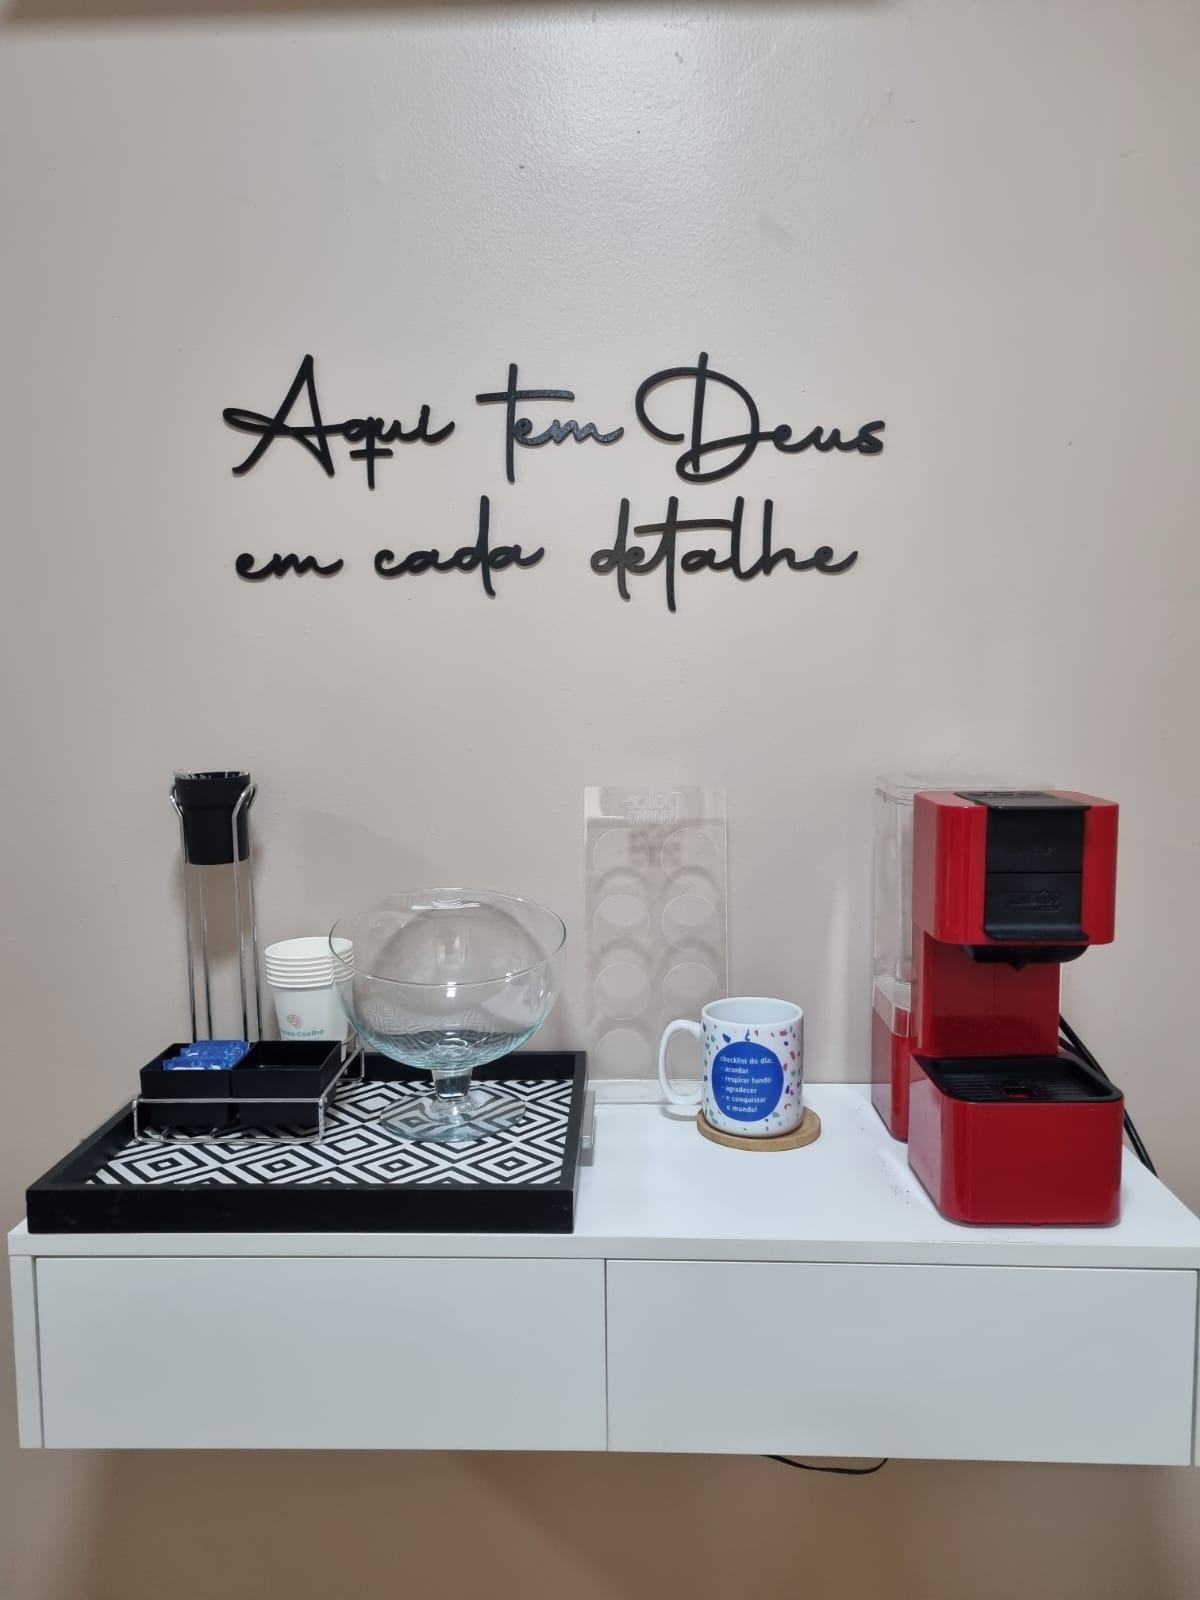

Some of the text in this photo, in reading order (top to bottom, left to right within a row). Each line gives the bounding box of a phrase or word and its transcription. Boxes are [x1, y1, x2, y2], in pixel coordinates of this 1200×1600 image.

[223, 351, 886, 489] Aqui tem Deus
[235, 494, 859, 612] em cada detalhe
[720, 1056, 747, 1064] checklist
[725, 1066, 749, 1074] acordar
[725, 1076, 750, 1084] respirar
[752, 1076, 772, 1084] fundo
[725, 1086, 757, 1094] agradecer
[731, 1096, 766, 1104] conquistar
